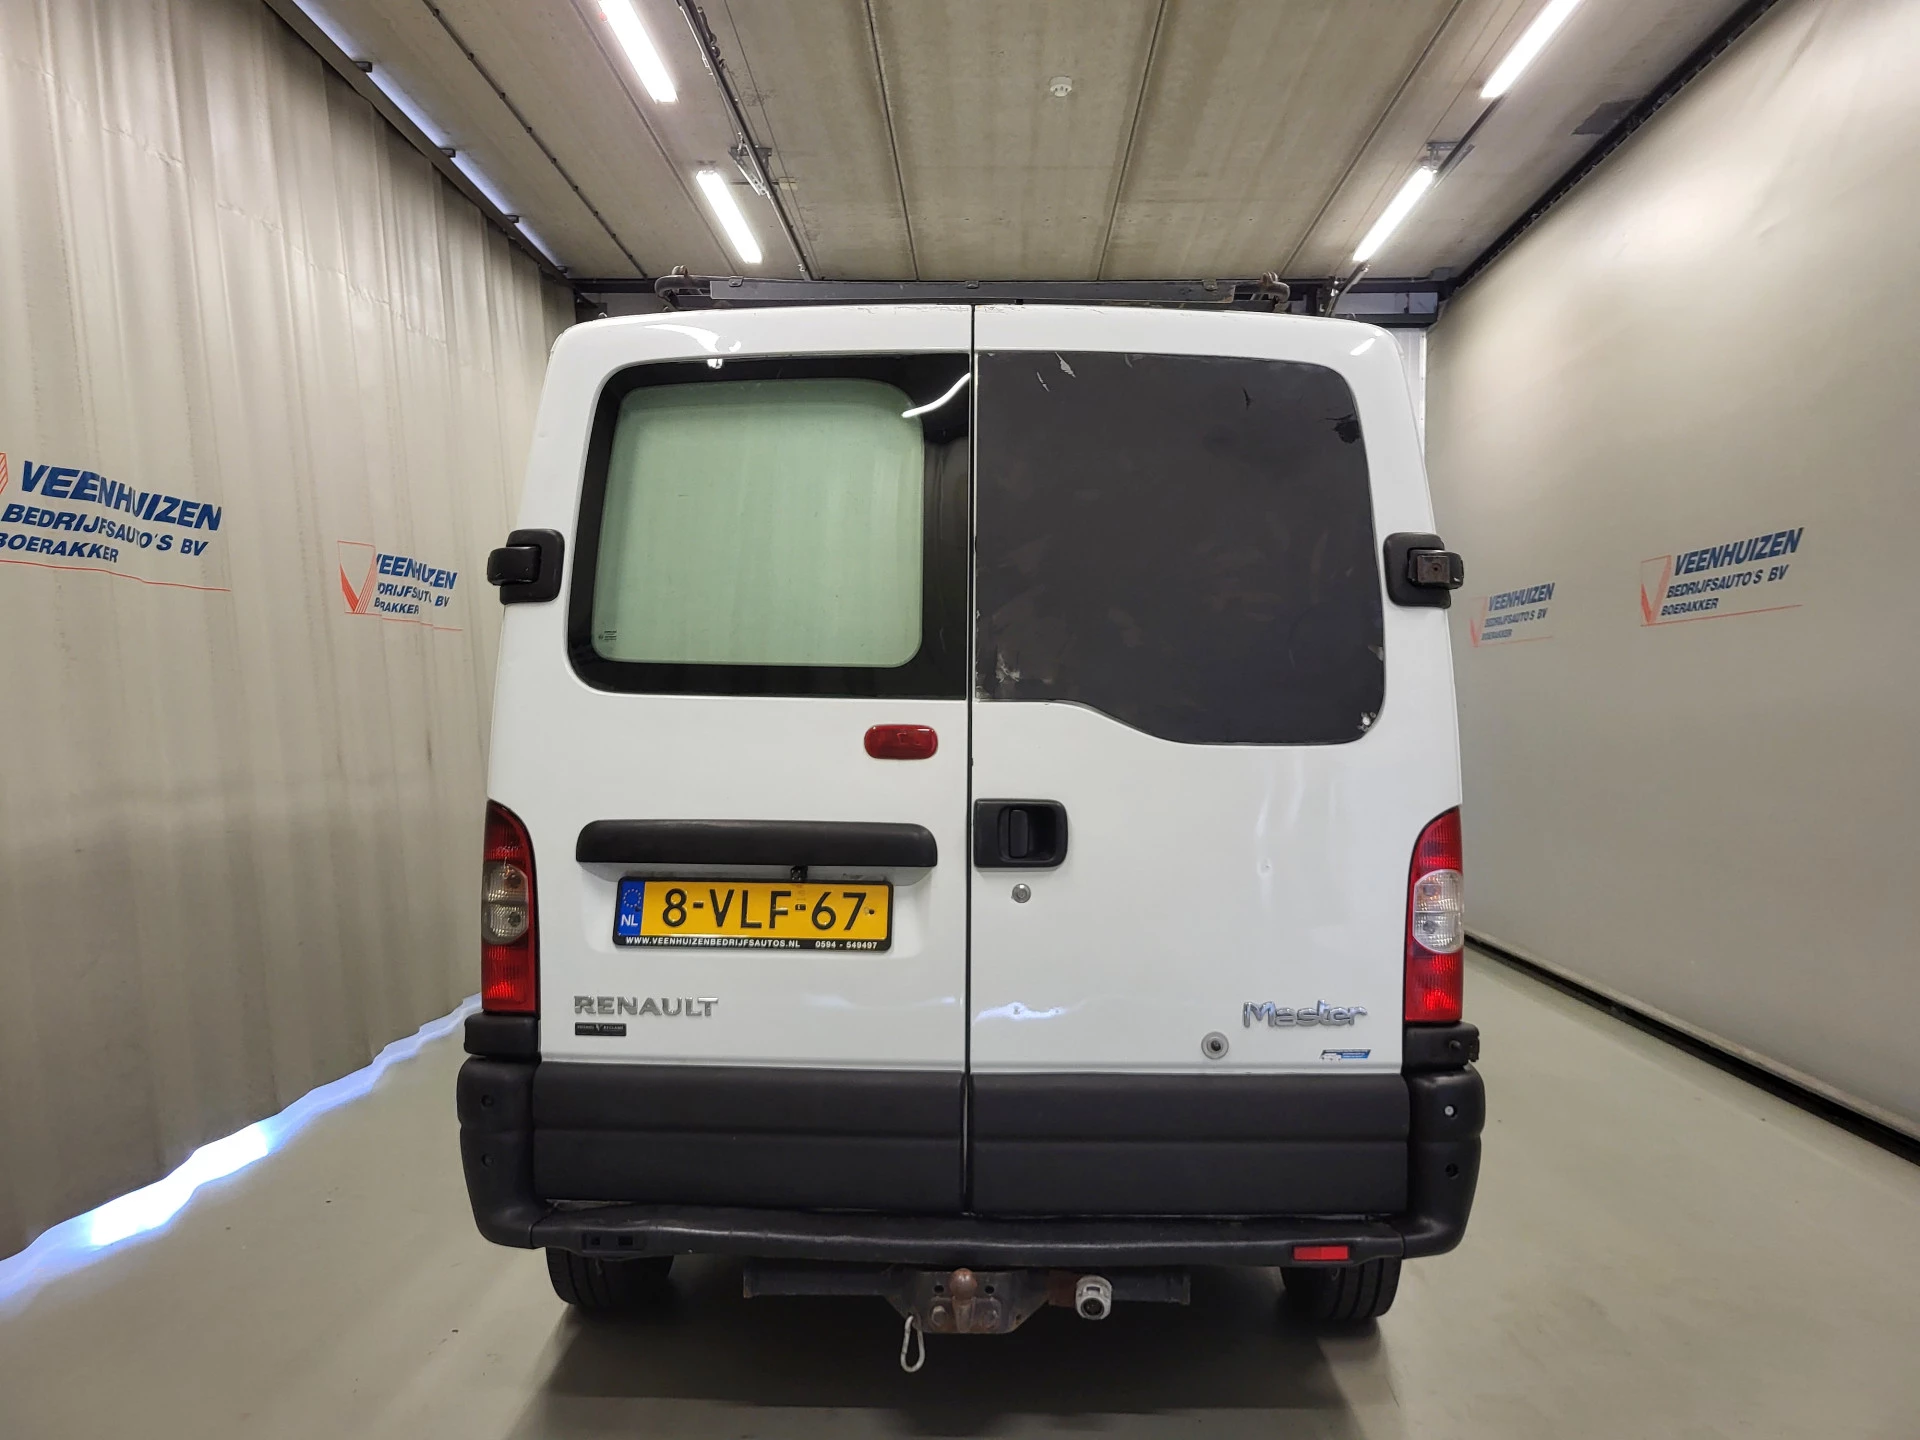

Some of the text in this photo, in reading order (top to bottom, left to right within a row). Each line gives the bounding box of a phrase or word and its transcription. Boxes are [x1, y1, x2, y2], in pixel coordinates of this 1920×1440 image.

[21, 460, 222, 531] VEENHUIZEN
[180, 538, 209, 556] BV
[1674, 527, 1804, 576] VEENHUIZEN
[1666, 564, 1789, 598] BEDRIJFSAUTO'S BV
[434, 595, 450, 608] BV
[1488, 582, 1555, 612] VEENHUIZEN
[1661, 598, 1719, 616] BOERAKKER
[620, 914, 638, 927] NL
[662, 888, 867, 931] 8-VLF-67
[626, 936, 800, 949] WWW.VEENHUIZENBEDRIJFSAUTOS.NL
[815, 940, 836, 950] 0594
[846, 941, 878, 950] 549497
[574, 995, 718, 1017] RENAULT
[1243, 999, 1368, 1028] Master
